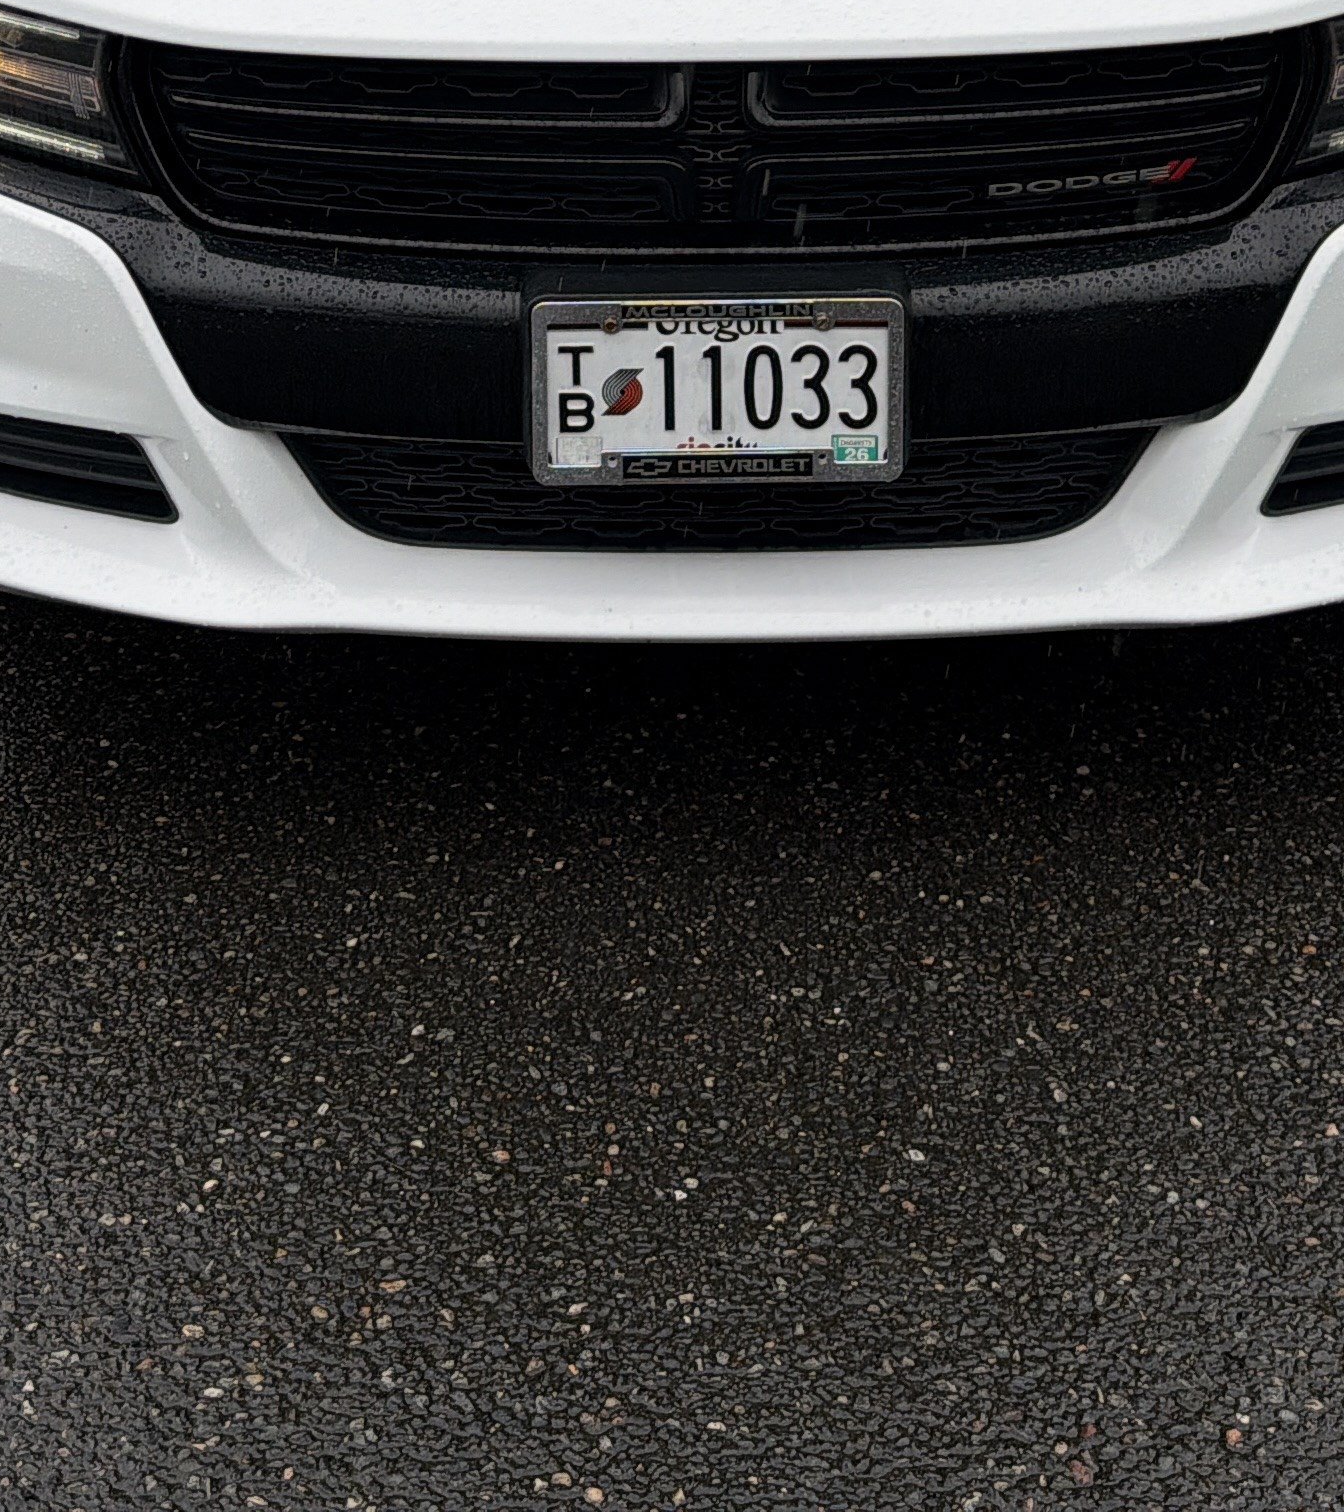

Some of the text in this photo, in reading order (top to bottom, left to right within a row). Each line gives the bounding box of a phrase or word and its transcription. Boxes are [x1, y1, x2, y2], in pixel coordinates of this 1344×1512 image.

[988, 165, 1171, 197] DODGE
[656, 320, 783, 343] Oregon
[656, 345, 878, 431] 11033
[677, 457, 811, 474] CHEVROLET
[844, 447, 870, 461] 26
